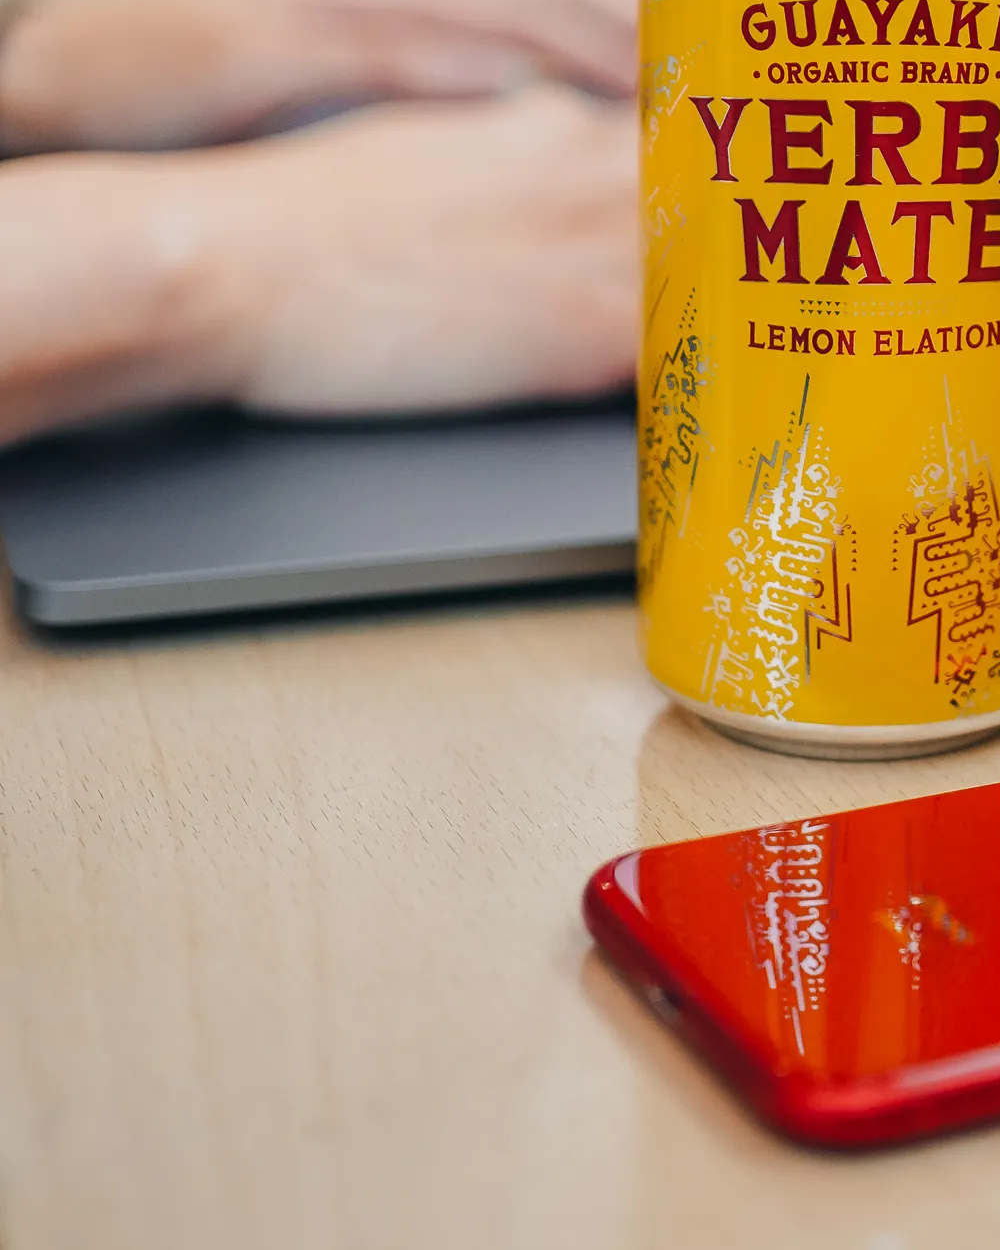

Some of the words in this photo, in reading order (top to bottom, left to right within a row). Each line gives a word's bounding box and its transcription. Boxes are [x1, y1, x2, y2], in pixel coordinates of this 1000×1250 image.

[767, 61, 889, 85] ORGANIC
[900, 62, 990, 85] BRAND
[748, 320, 857, 356] LEMON
